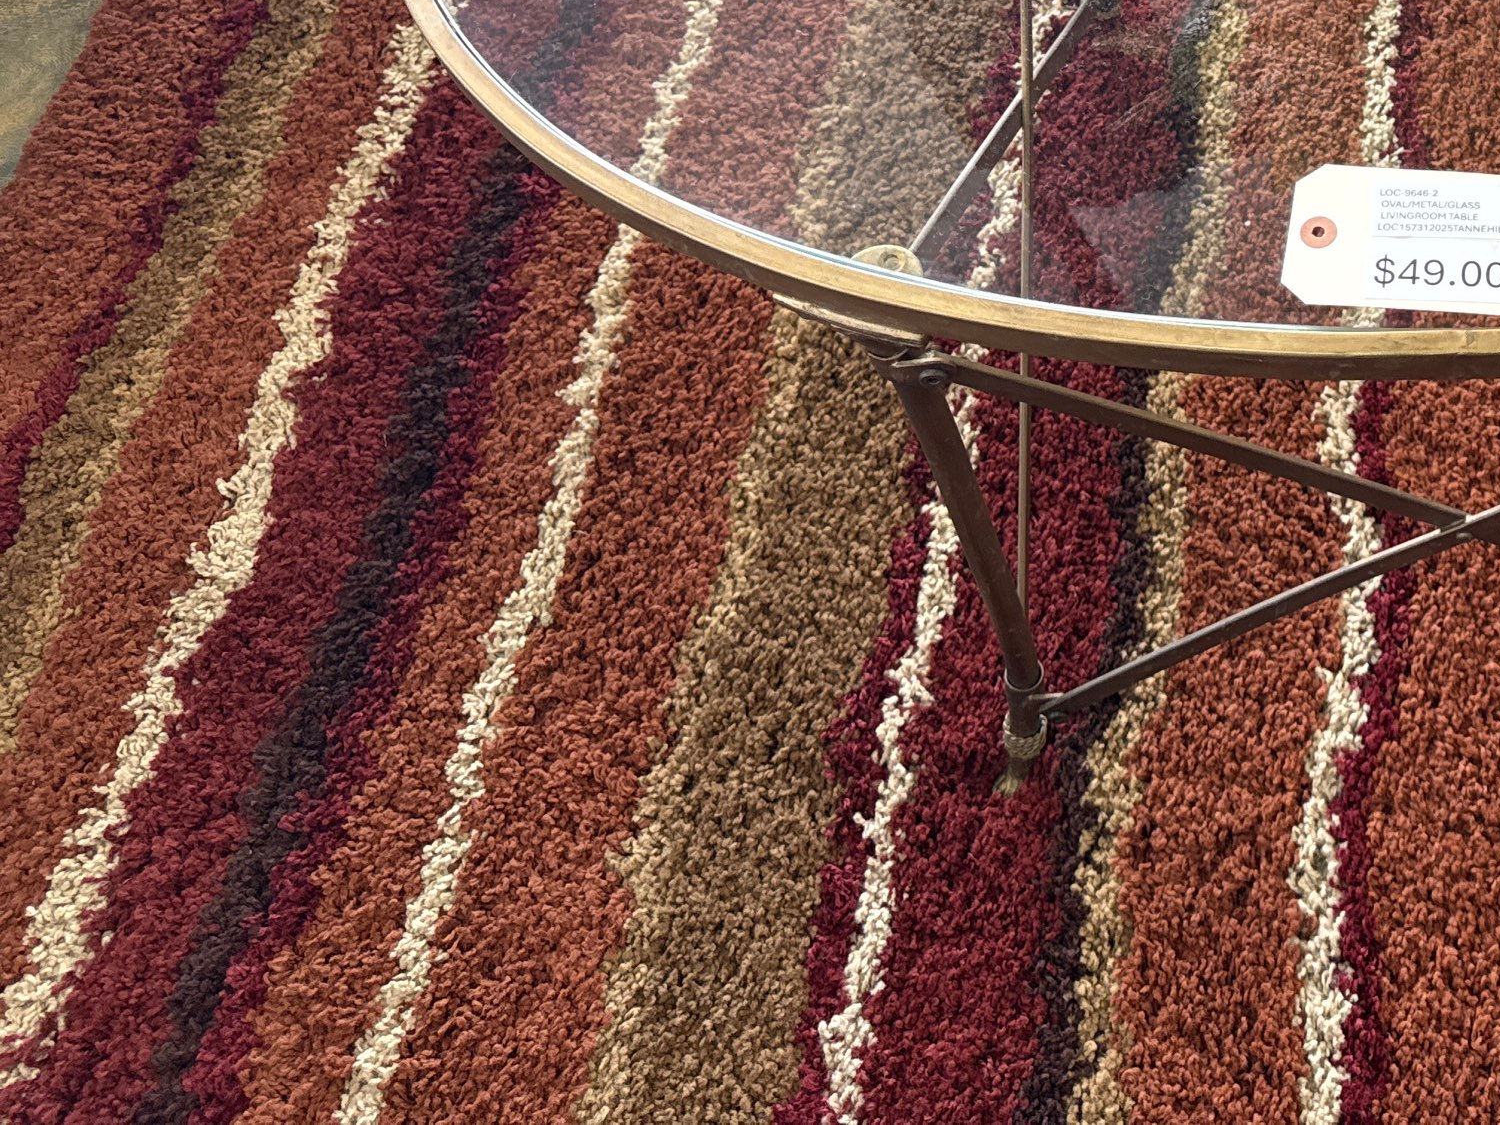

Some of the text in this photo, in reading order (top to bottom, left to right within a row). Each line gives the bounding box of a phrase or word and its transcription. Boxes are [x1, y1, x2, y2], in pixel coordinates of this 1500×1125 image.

[1381, 199, 1481, 209] OVAL/METAL/GLASS
[1380, 211, 1479, 221] LIVINGROOM TABLE
